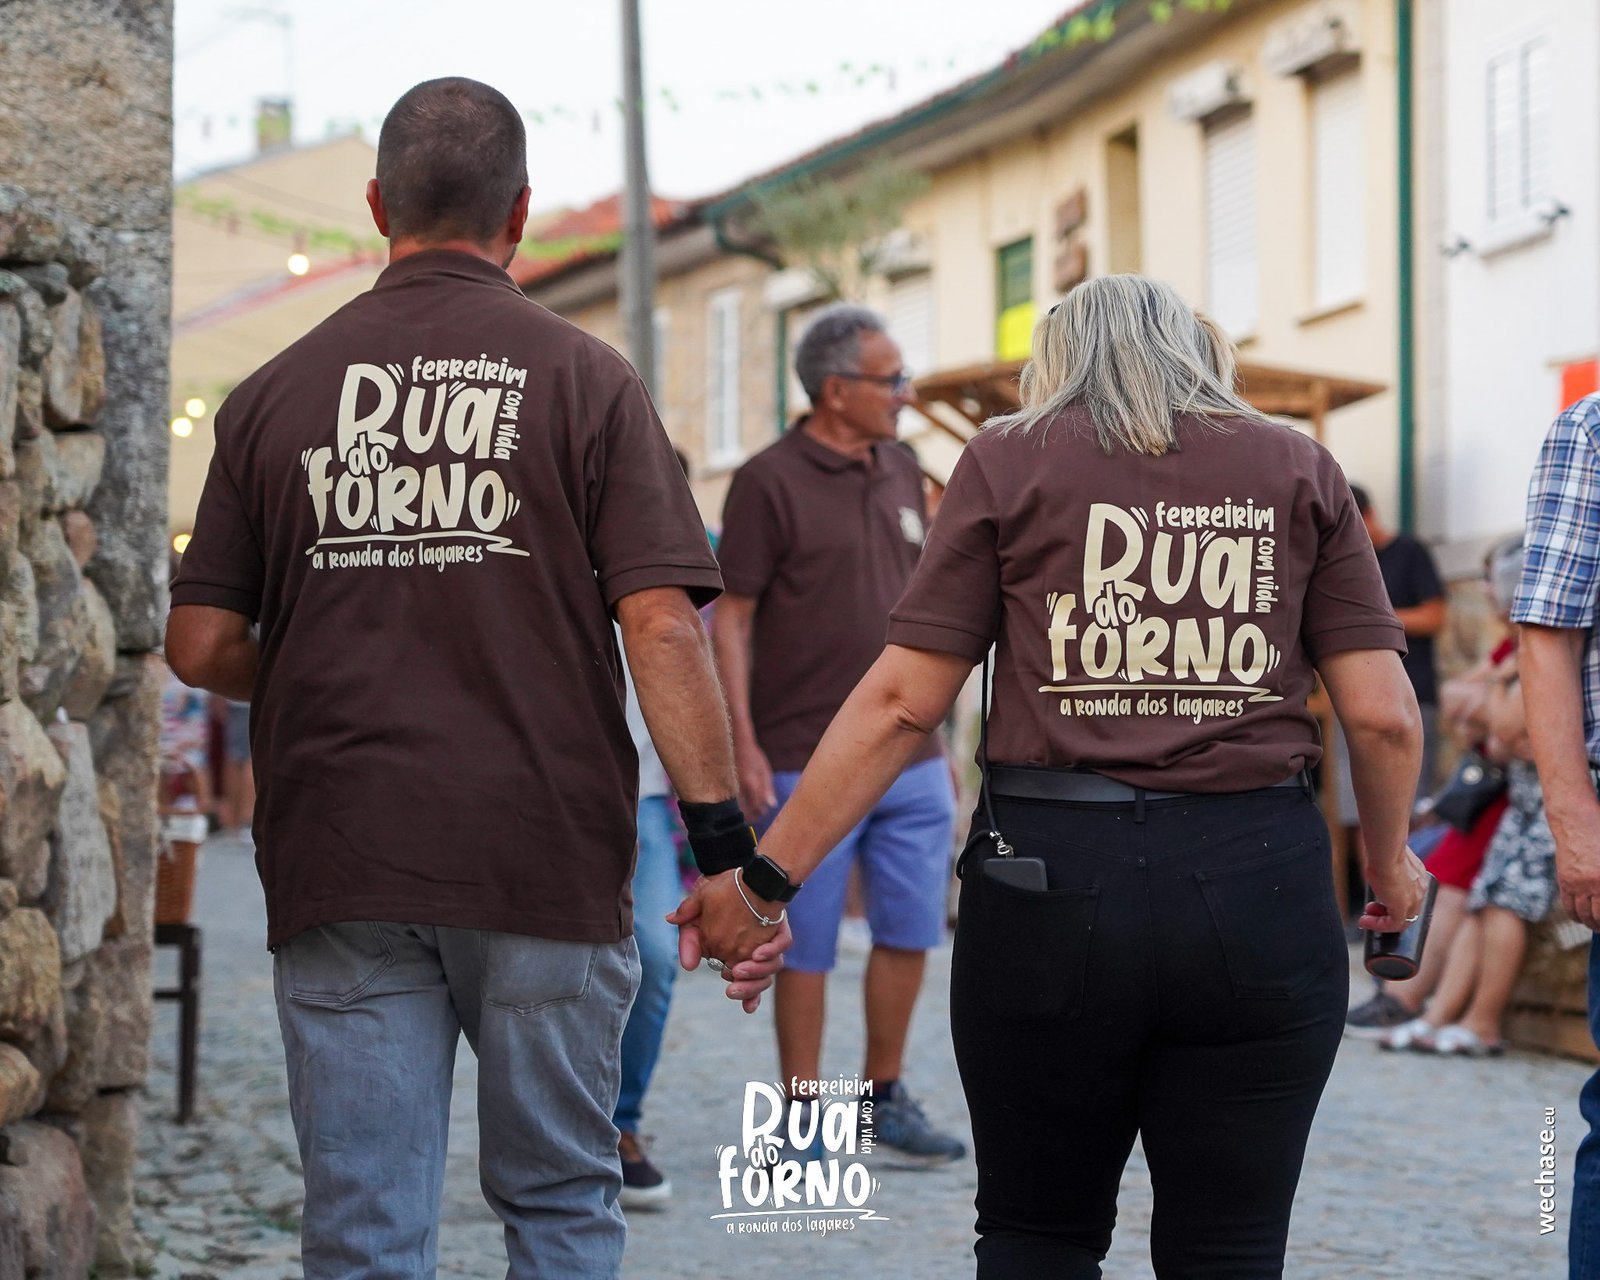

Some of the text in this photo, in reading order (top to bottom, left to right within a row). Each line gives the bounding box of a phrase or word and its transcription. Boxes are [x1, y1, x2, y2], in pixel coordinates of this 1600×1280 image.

[349, 434, 388, 475] do
[494, 424, 520, 460] vida
[312, 552, 323, 569] a
[388, 544, 414, 567] dos
[1095, 583, 1136, 627] do
[1255, 576, 1279, 613] vida
[1060, 698, 1071, 716] a
[1137, 693, 1167, 715] dos
